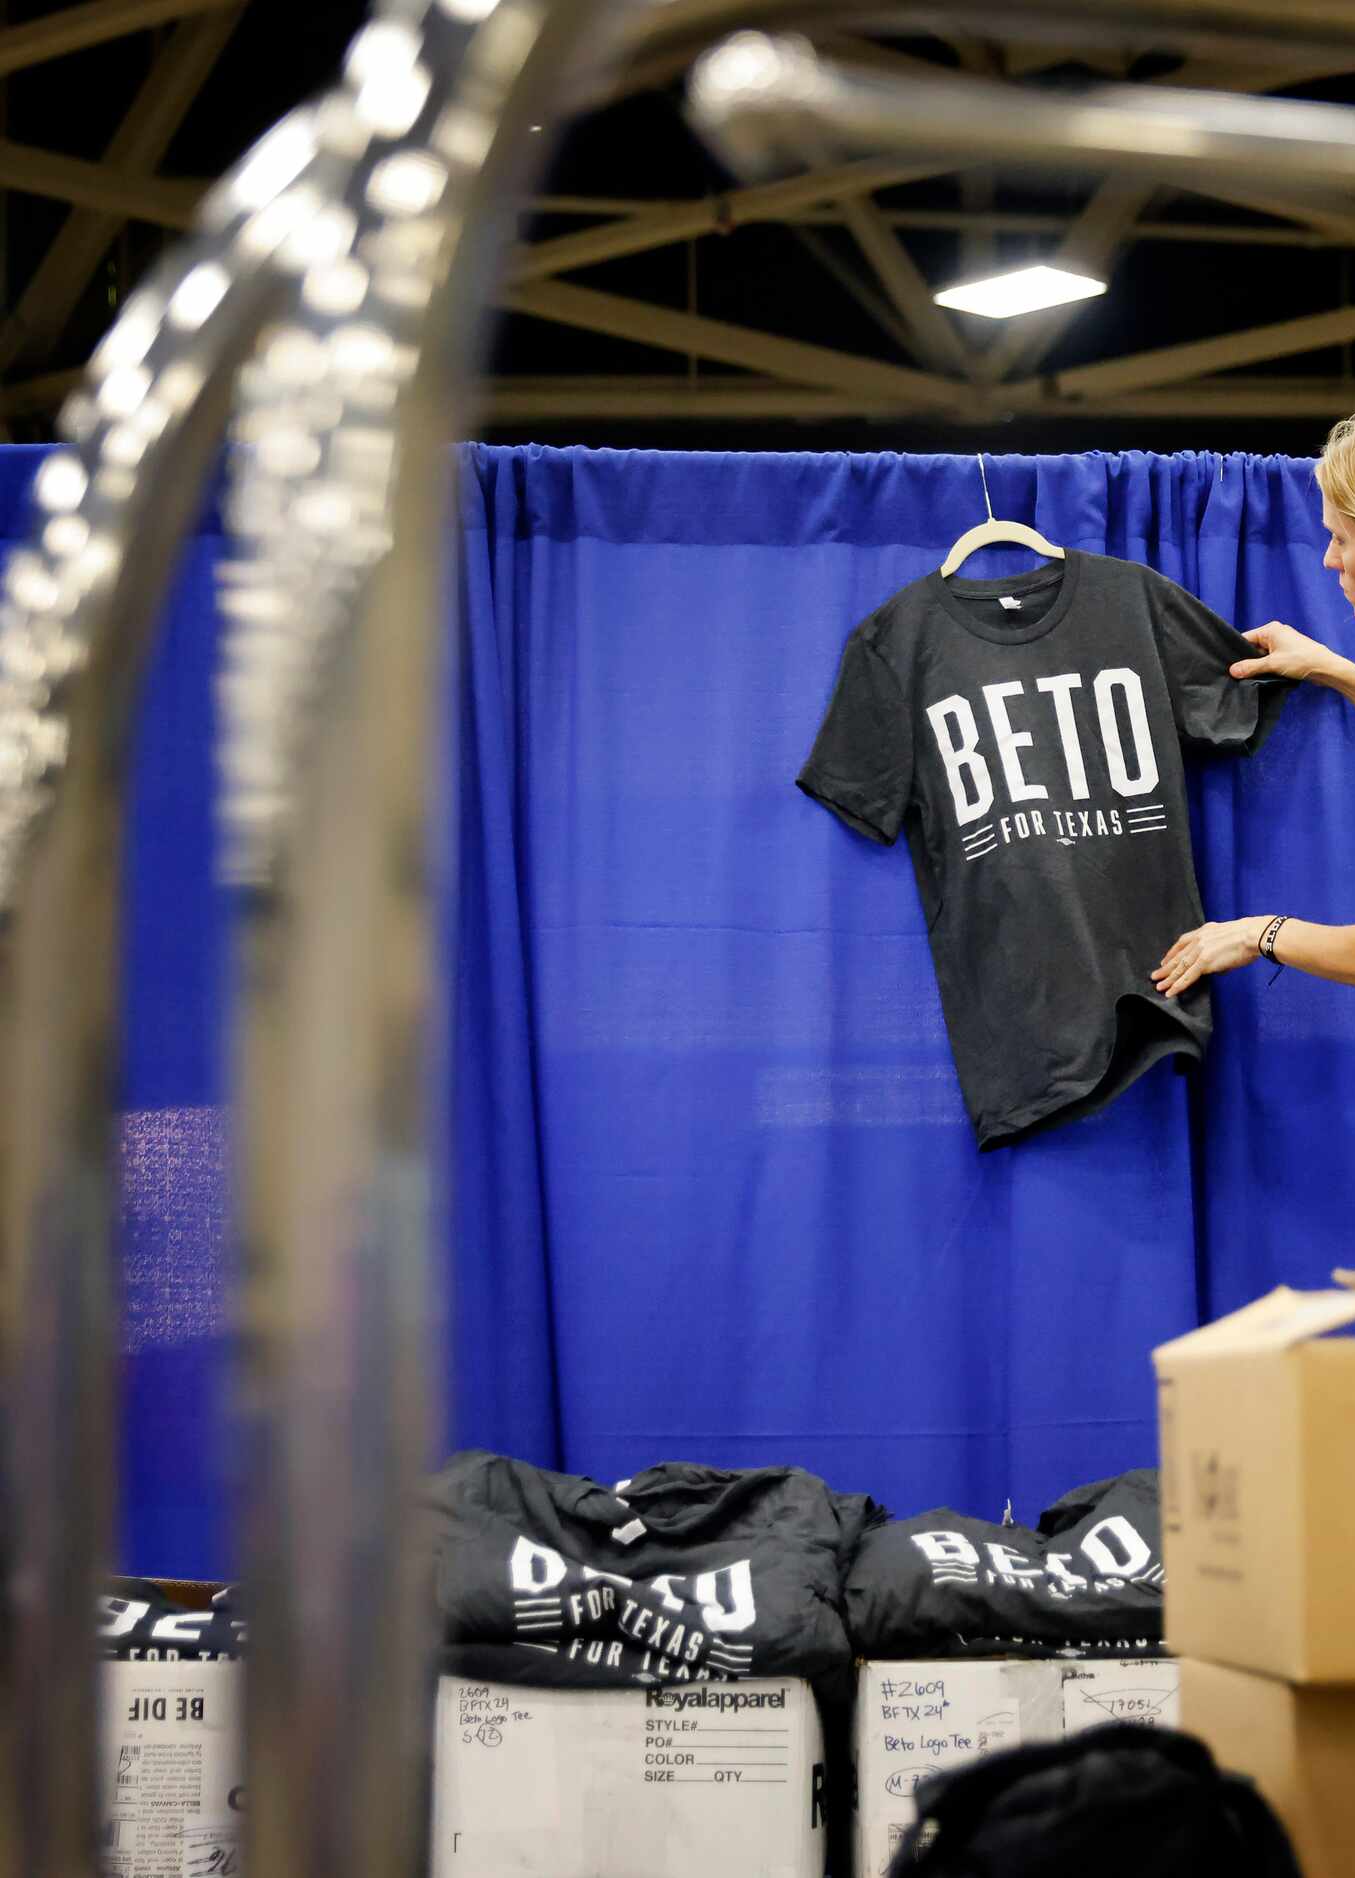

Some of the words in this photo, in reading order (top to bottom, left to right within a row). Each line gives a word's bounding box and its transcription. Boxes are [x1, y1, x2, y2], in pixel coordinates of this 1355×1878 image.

[926, 667, 1160, 827] BETO
[1000, 812, 1046, 844] FOR
[1054, 809, 1124, 838] TEXAS
[619, 1599, 704, 1661] TEXAS
[645, 1720, 698, 1732] STYLE#
[645, 1736, 673, 1748] PO#
[884, 1735, 915, 1752] Beto
[920, 1735, 948, 1756] Logo
[950, 1733, 974, 1750] Tee
[644, 1753, 695, 1766] COLOR
[644, 1770, 676, 1783] SIZE
[714, 1770, 743, 1783] QTY
